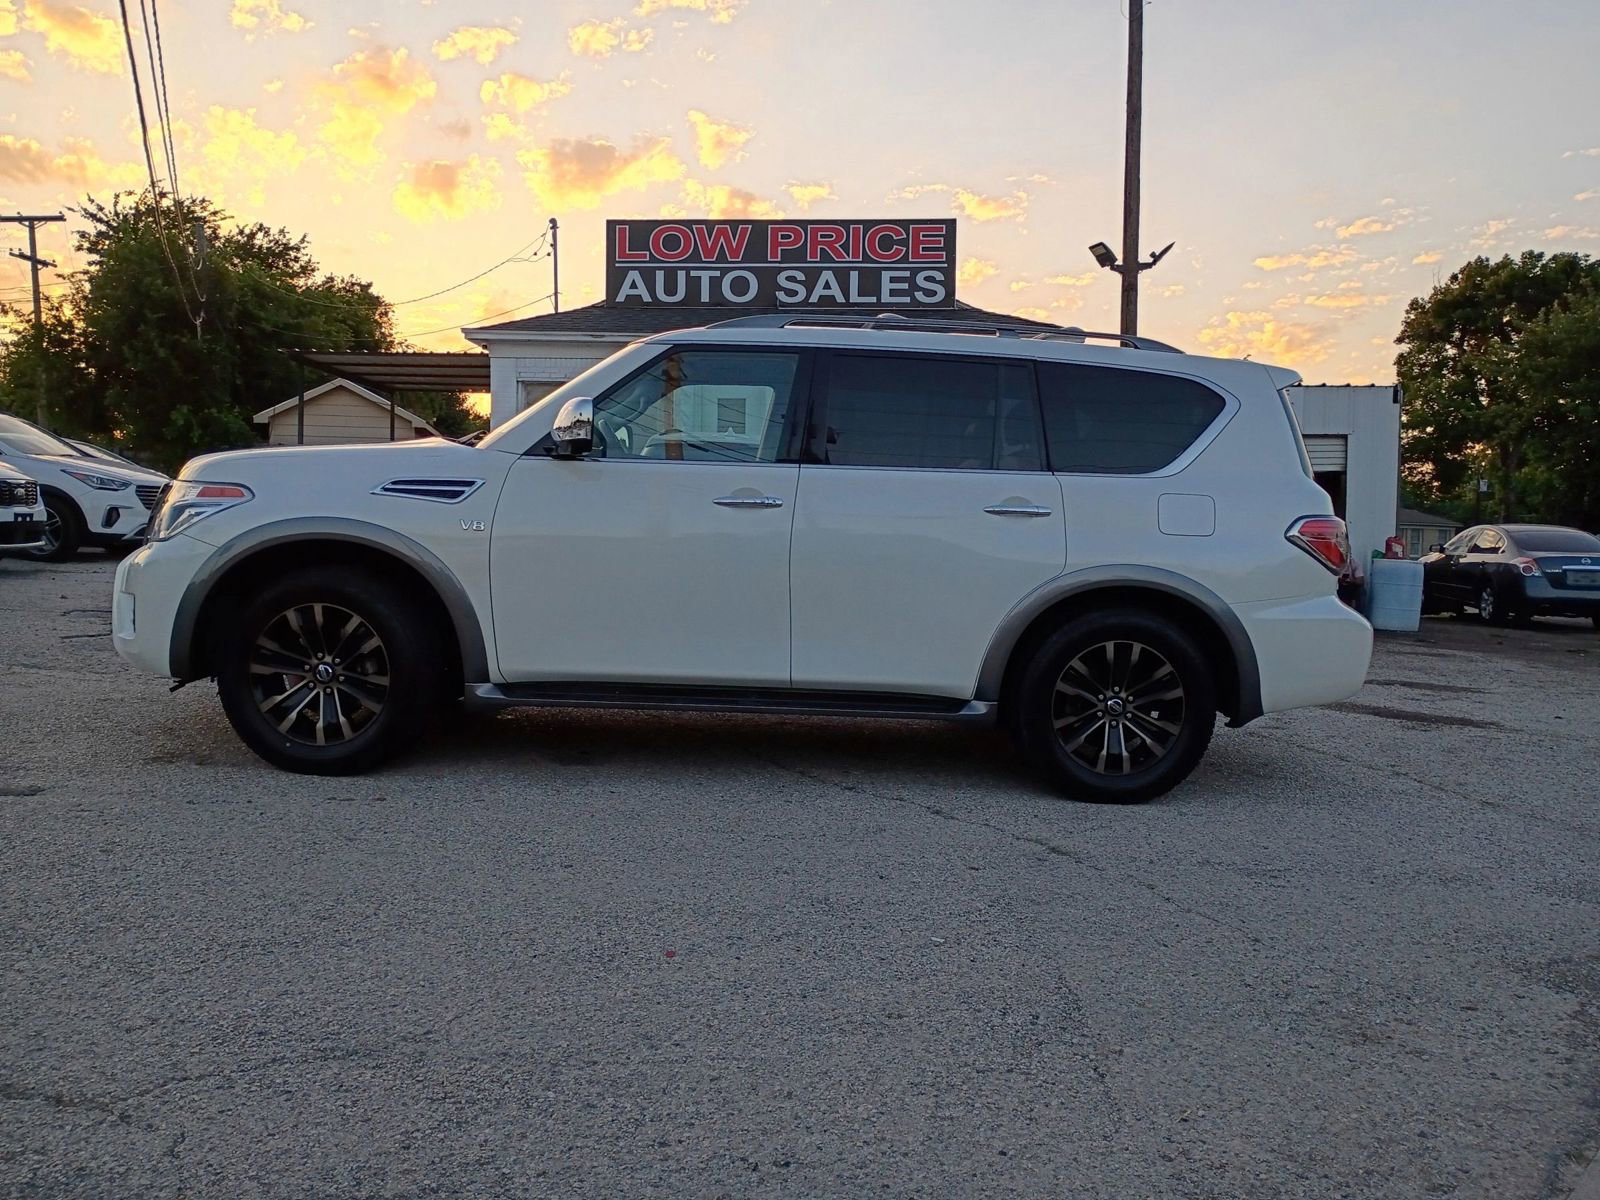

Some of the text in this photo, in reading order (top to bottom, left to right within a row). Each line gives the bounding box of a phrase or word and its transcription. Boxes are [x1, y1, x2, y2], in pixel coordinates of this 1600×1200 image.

[615, 224, 946, 262] LOW PRICE
[615, 269, 947, 304] AUTO SALES
[460, 519, 486, 531] V8
